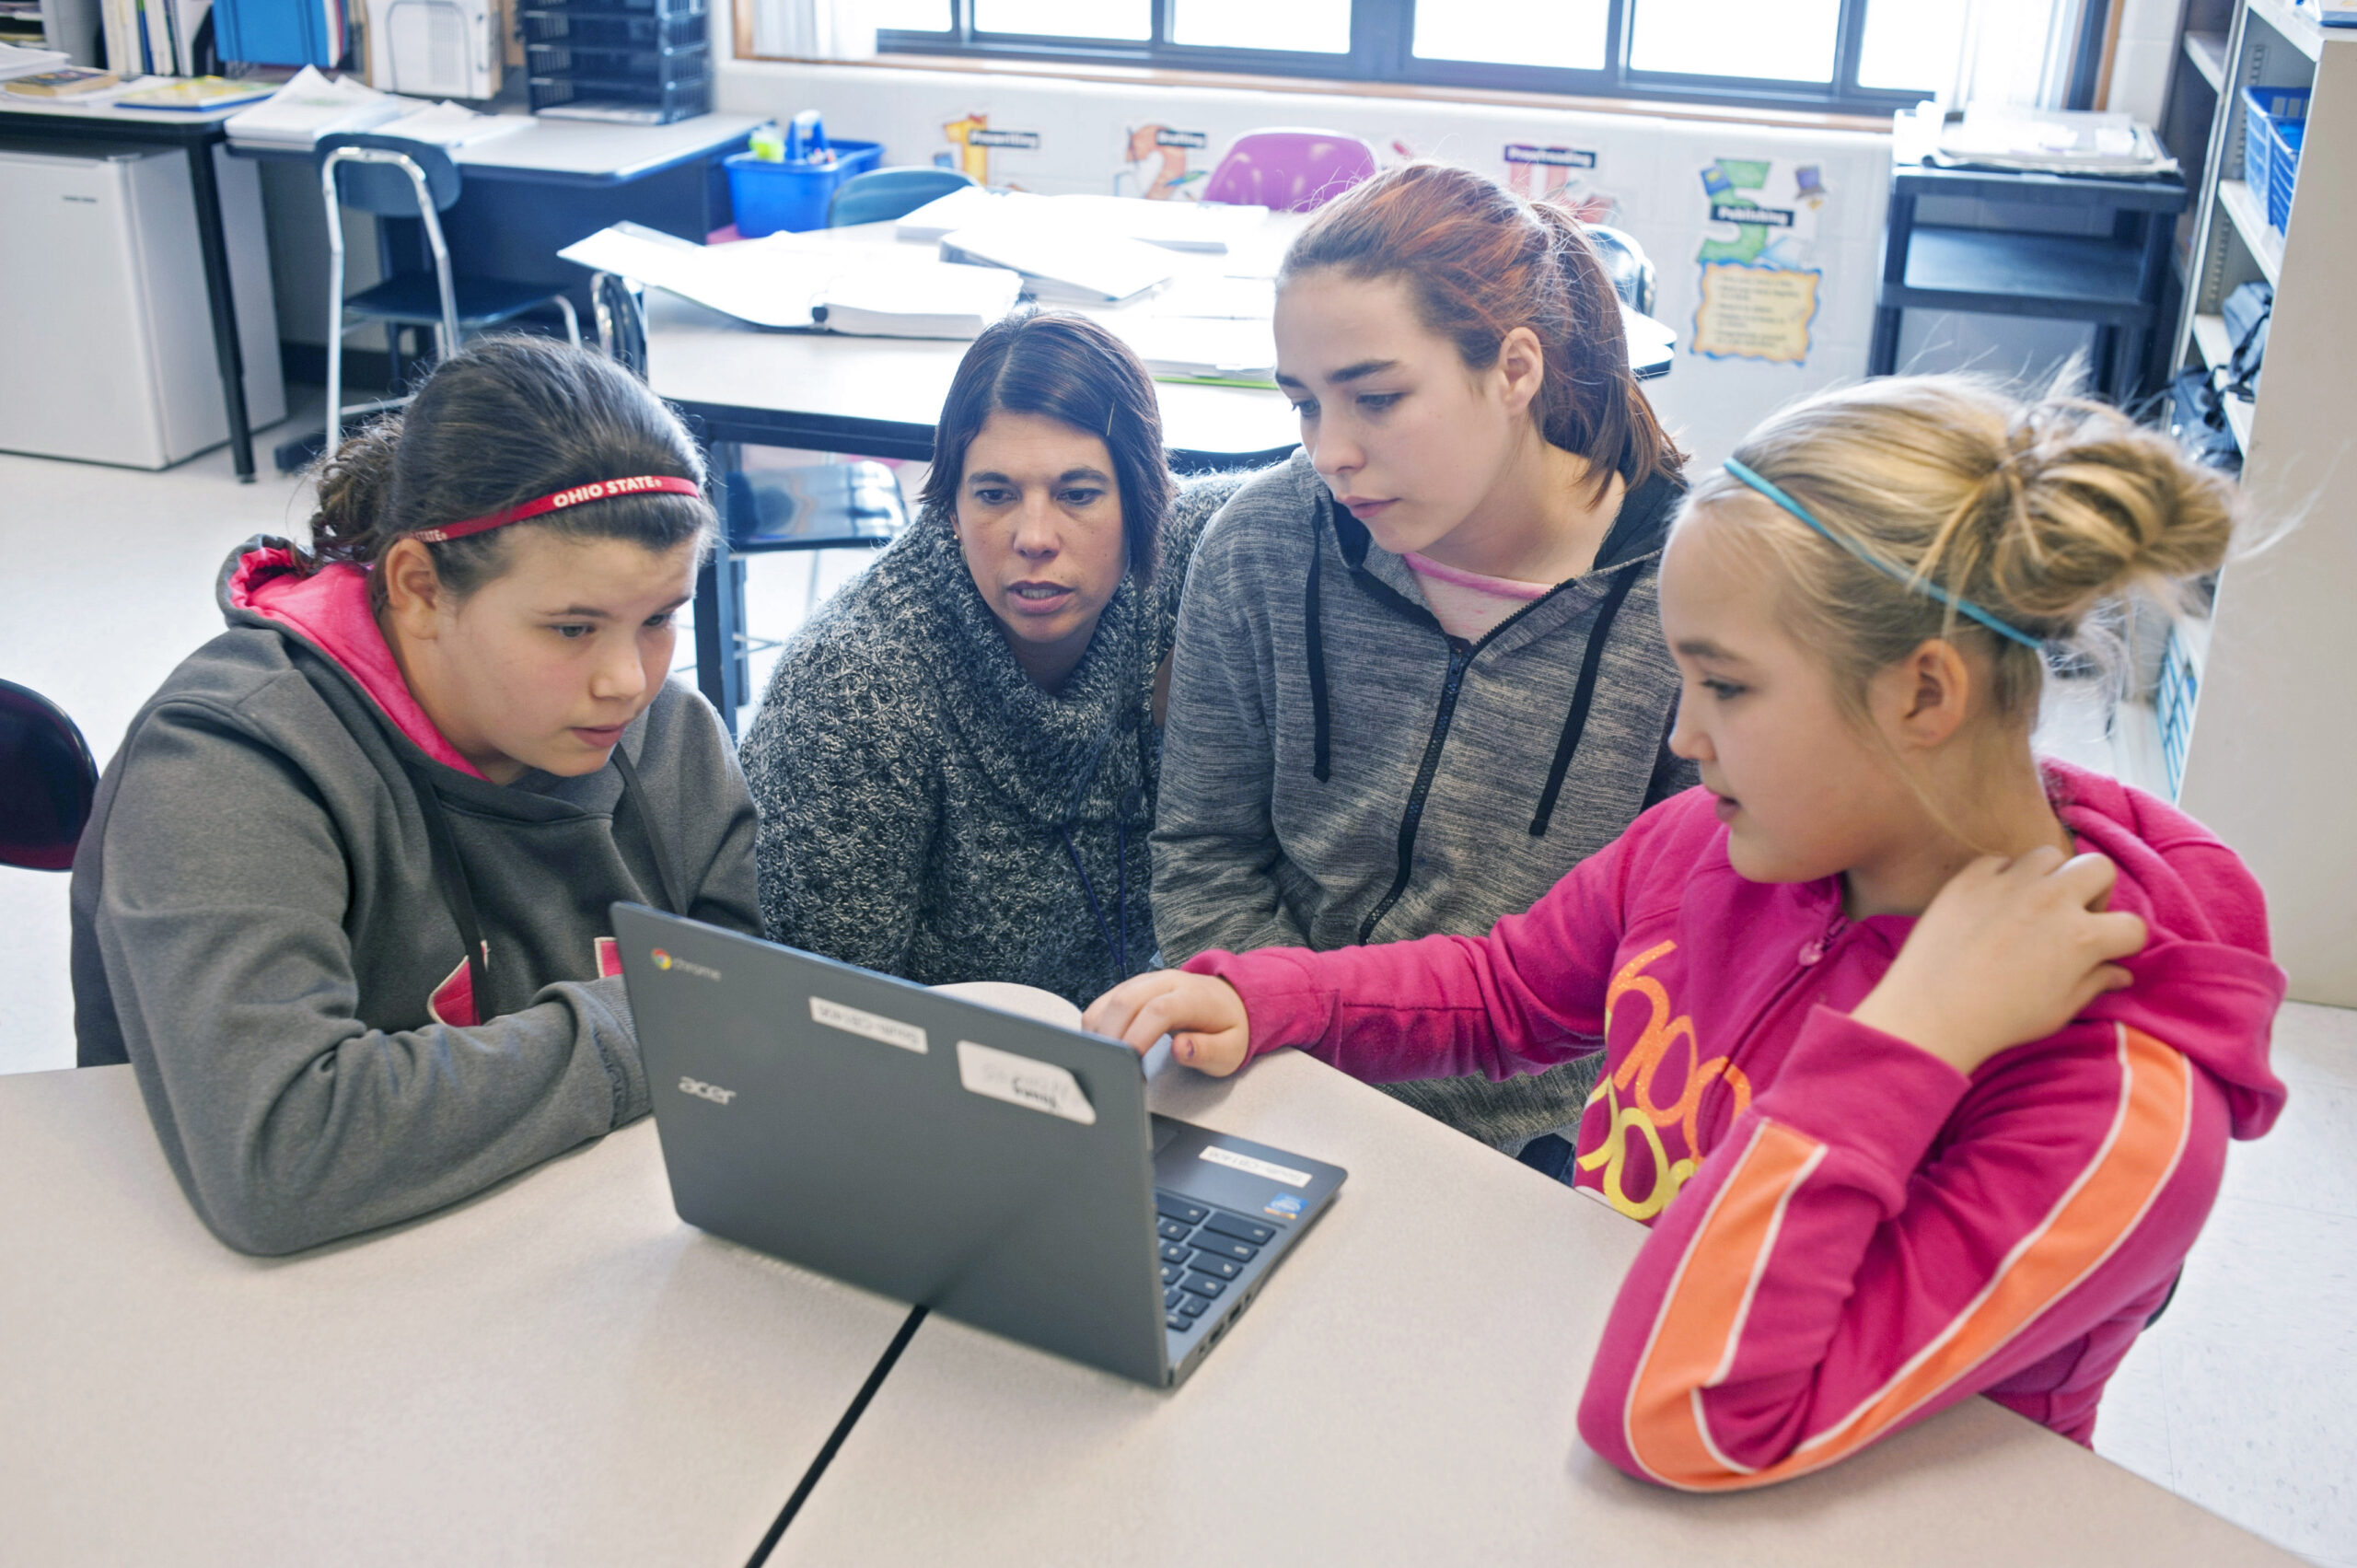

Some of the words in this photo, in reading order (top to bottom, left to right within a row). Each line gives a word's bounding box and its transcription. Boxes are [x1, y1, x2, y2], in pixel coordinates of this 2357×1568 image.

[970, 131, 1038, 148] Prewriting
[1158, 130, 1204, 147] Drafting
[1506, 145, 1593, 168] Proofreading
[1716, 204, 1789, 227] Publishing
[553, 483, 604, 507] OHIO
[673, 958, 722, 982] chrome
[678, 1075, 737, 1105] acer
